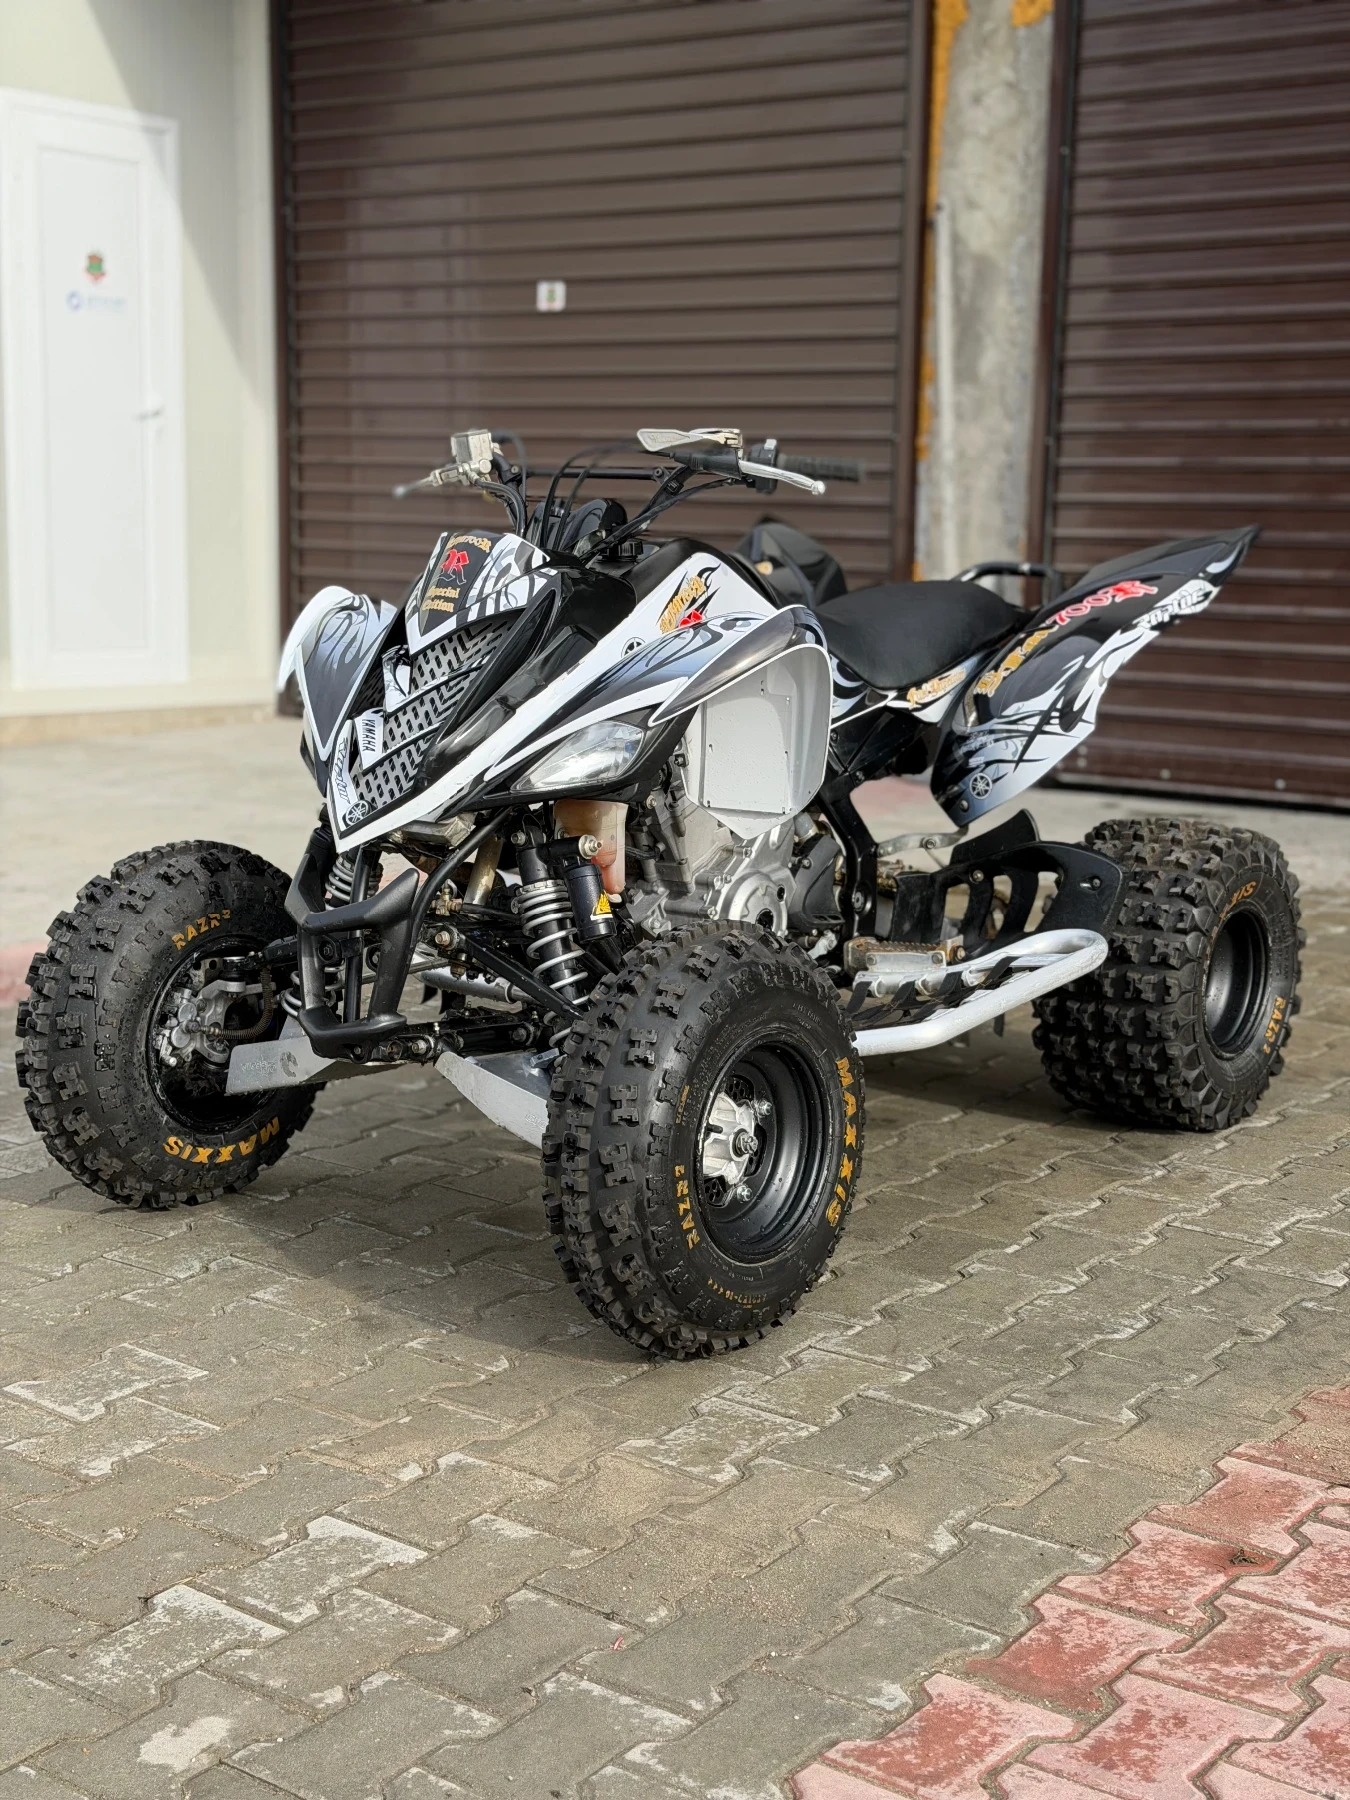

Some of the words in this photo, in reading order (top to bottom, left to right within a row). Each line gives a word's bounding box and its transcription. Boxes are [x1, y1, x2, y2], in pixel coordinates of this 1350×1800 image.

[361, 718, 377, 753] YAMAHA
[171, 913, 221, 951] RAZR
[1264, 996, 1287, 1044] RAZR
[162, 1116, 280, 1164] MAXXIS
[825, 1056, 857, 1228] MAXXIS
[675, 1179, 701, 1250] RAZR
